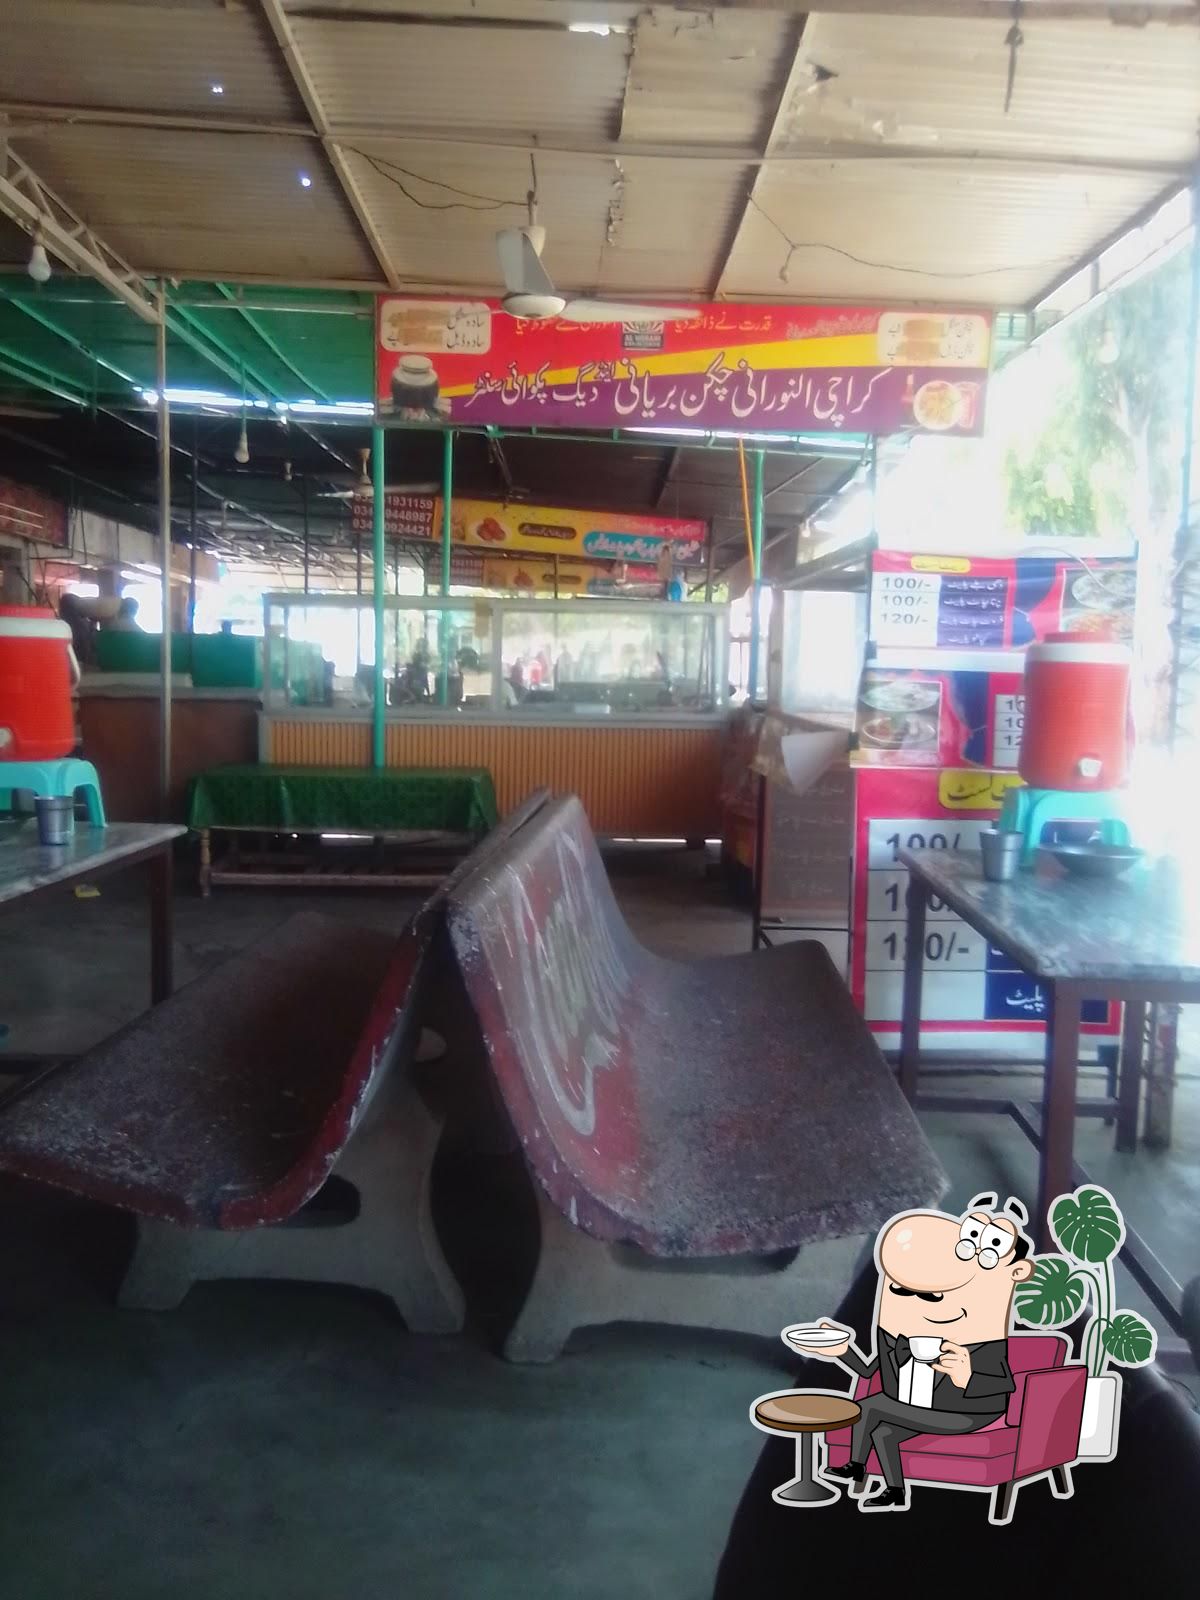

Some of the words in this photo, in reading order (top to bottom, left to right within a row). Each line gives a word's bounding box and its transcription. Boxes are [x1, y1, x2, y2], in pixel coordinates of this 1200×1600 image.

[464, 371, 503, 408] سنٹر
[501, 361, 551, 405] پکوائی
[552, 361, 599, 408] دیگ
[593, 360, 615, 383] اینڈ
[614, 357, 678, 418] بریانی
[679, 351, 735, 418] چکن
[731, 358, 812, 418] النورانی
[812, 366, 893, 428] کراچی
[881, 595, 930, 607] 100/-
[882, 577, 932, 590] 100/-
[881, 613, 929, 625] 120/-
[884, 932, 970, 961] 10/-
[1006, 985, 1045, 1013] پلیٹ
